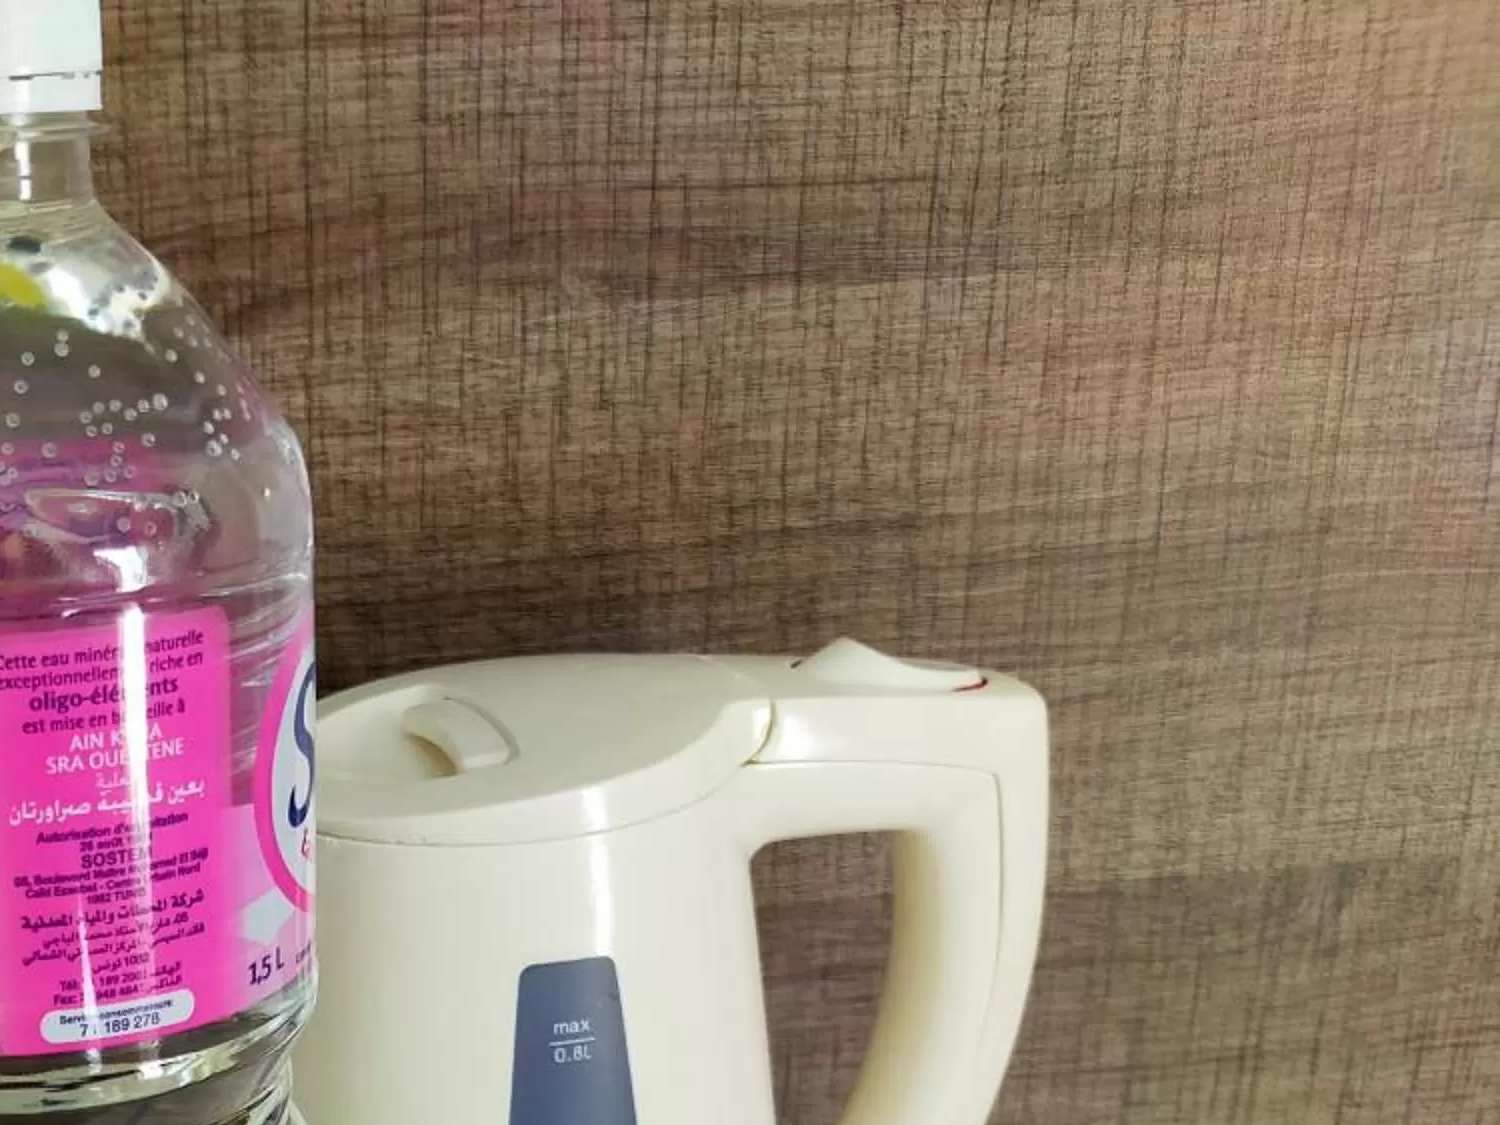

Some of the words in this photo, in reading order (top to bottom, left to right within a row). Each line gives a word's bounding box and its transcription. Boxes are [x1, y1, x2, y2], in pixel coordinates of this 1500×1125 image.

[42, 652, 69, 667] eau
[145, 629, 204, 652] naturelle
[150, 654, 184, 675] riche
[186, 651, 203, 666] en
[29, 676, 179, 714] oligo-élénts
[22, 719, 46, 734] est
[51, 715, 85, 731] mise
[89, 712, 107, 728] en
[70, 731, 104, 752] AIN
[46, 754, 84, 775] SRA
[247, 954, 271, 985] 1,5
[553, 1018, 592, 1035] max
